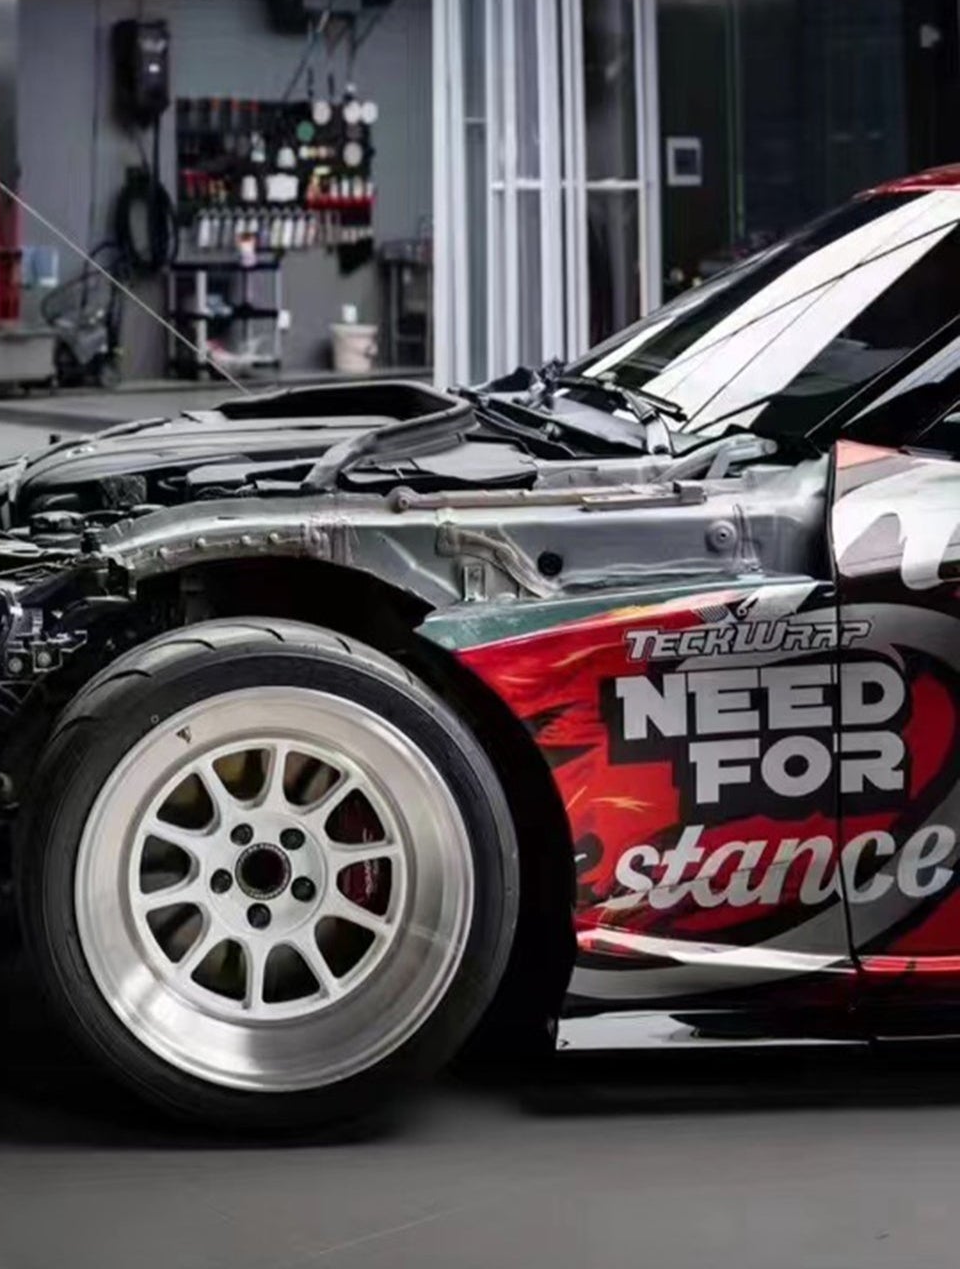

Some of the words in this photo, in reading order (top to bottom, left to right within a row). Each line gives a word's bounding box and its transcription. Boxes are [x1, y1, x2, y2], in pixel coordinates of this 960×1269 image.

[615, 661, 907, 740] NEED
[688, 731, 905, 804] FOR
[595, 824, 956, 910] stance
